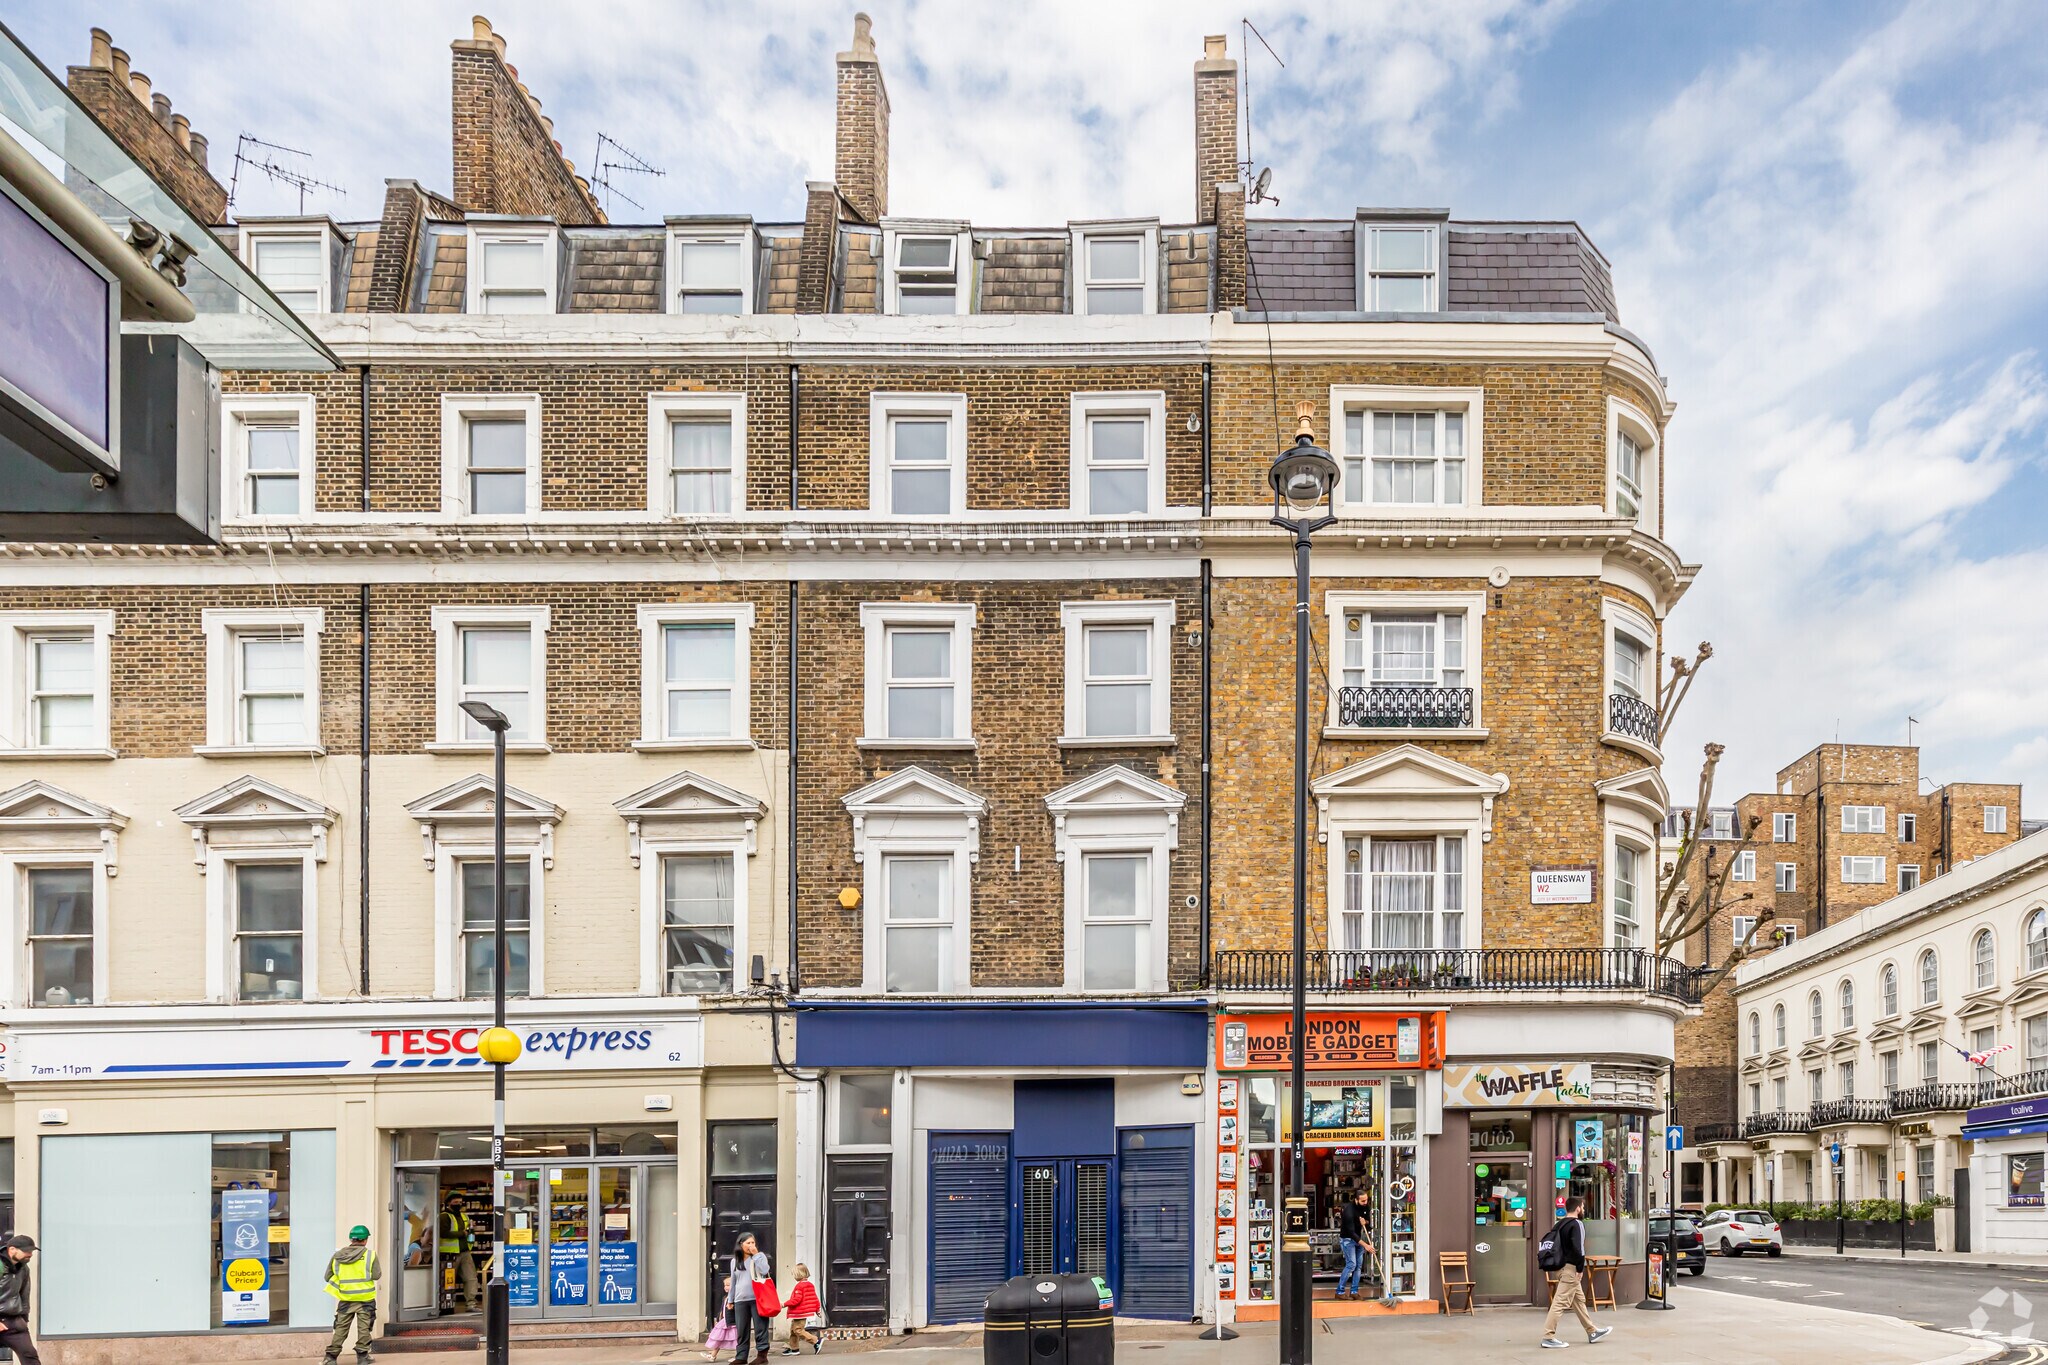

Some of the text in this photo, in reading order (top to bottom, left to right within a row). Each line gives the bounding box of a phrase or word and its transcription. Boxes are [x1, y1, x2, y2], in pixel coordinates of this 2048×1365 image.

[1537, 875, 1586, 883] QUEENSWAY
[1537, 884, 1550, 892] W2
[1285, 1020, 1360, 1035] LNDON
[370, 1027, 652, 1060] TESC express
[1248, 1034, 1397, 1050] MOBIE GADGET
[668, 1052, 680, 1061] 62
[32, 1066, 54, 1074] 7am
[62, 1065, 92, 1075] 11pm
[1475, 1073, 1488, 1082] the
[1481, 1069, 1564, 1098] WAFFLE
[1034, 1168, 1050, 1178] 60
